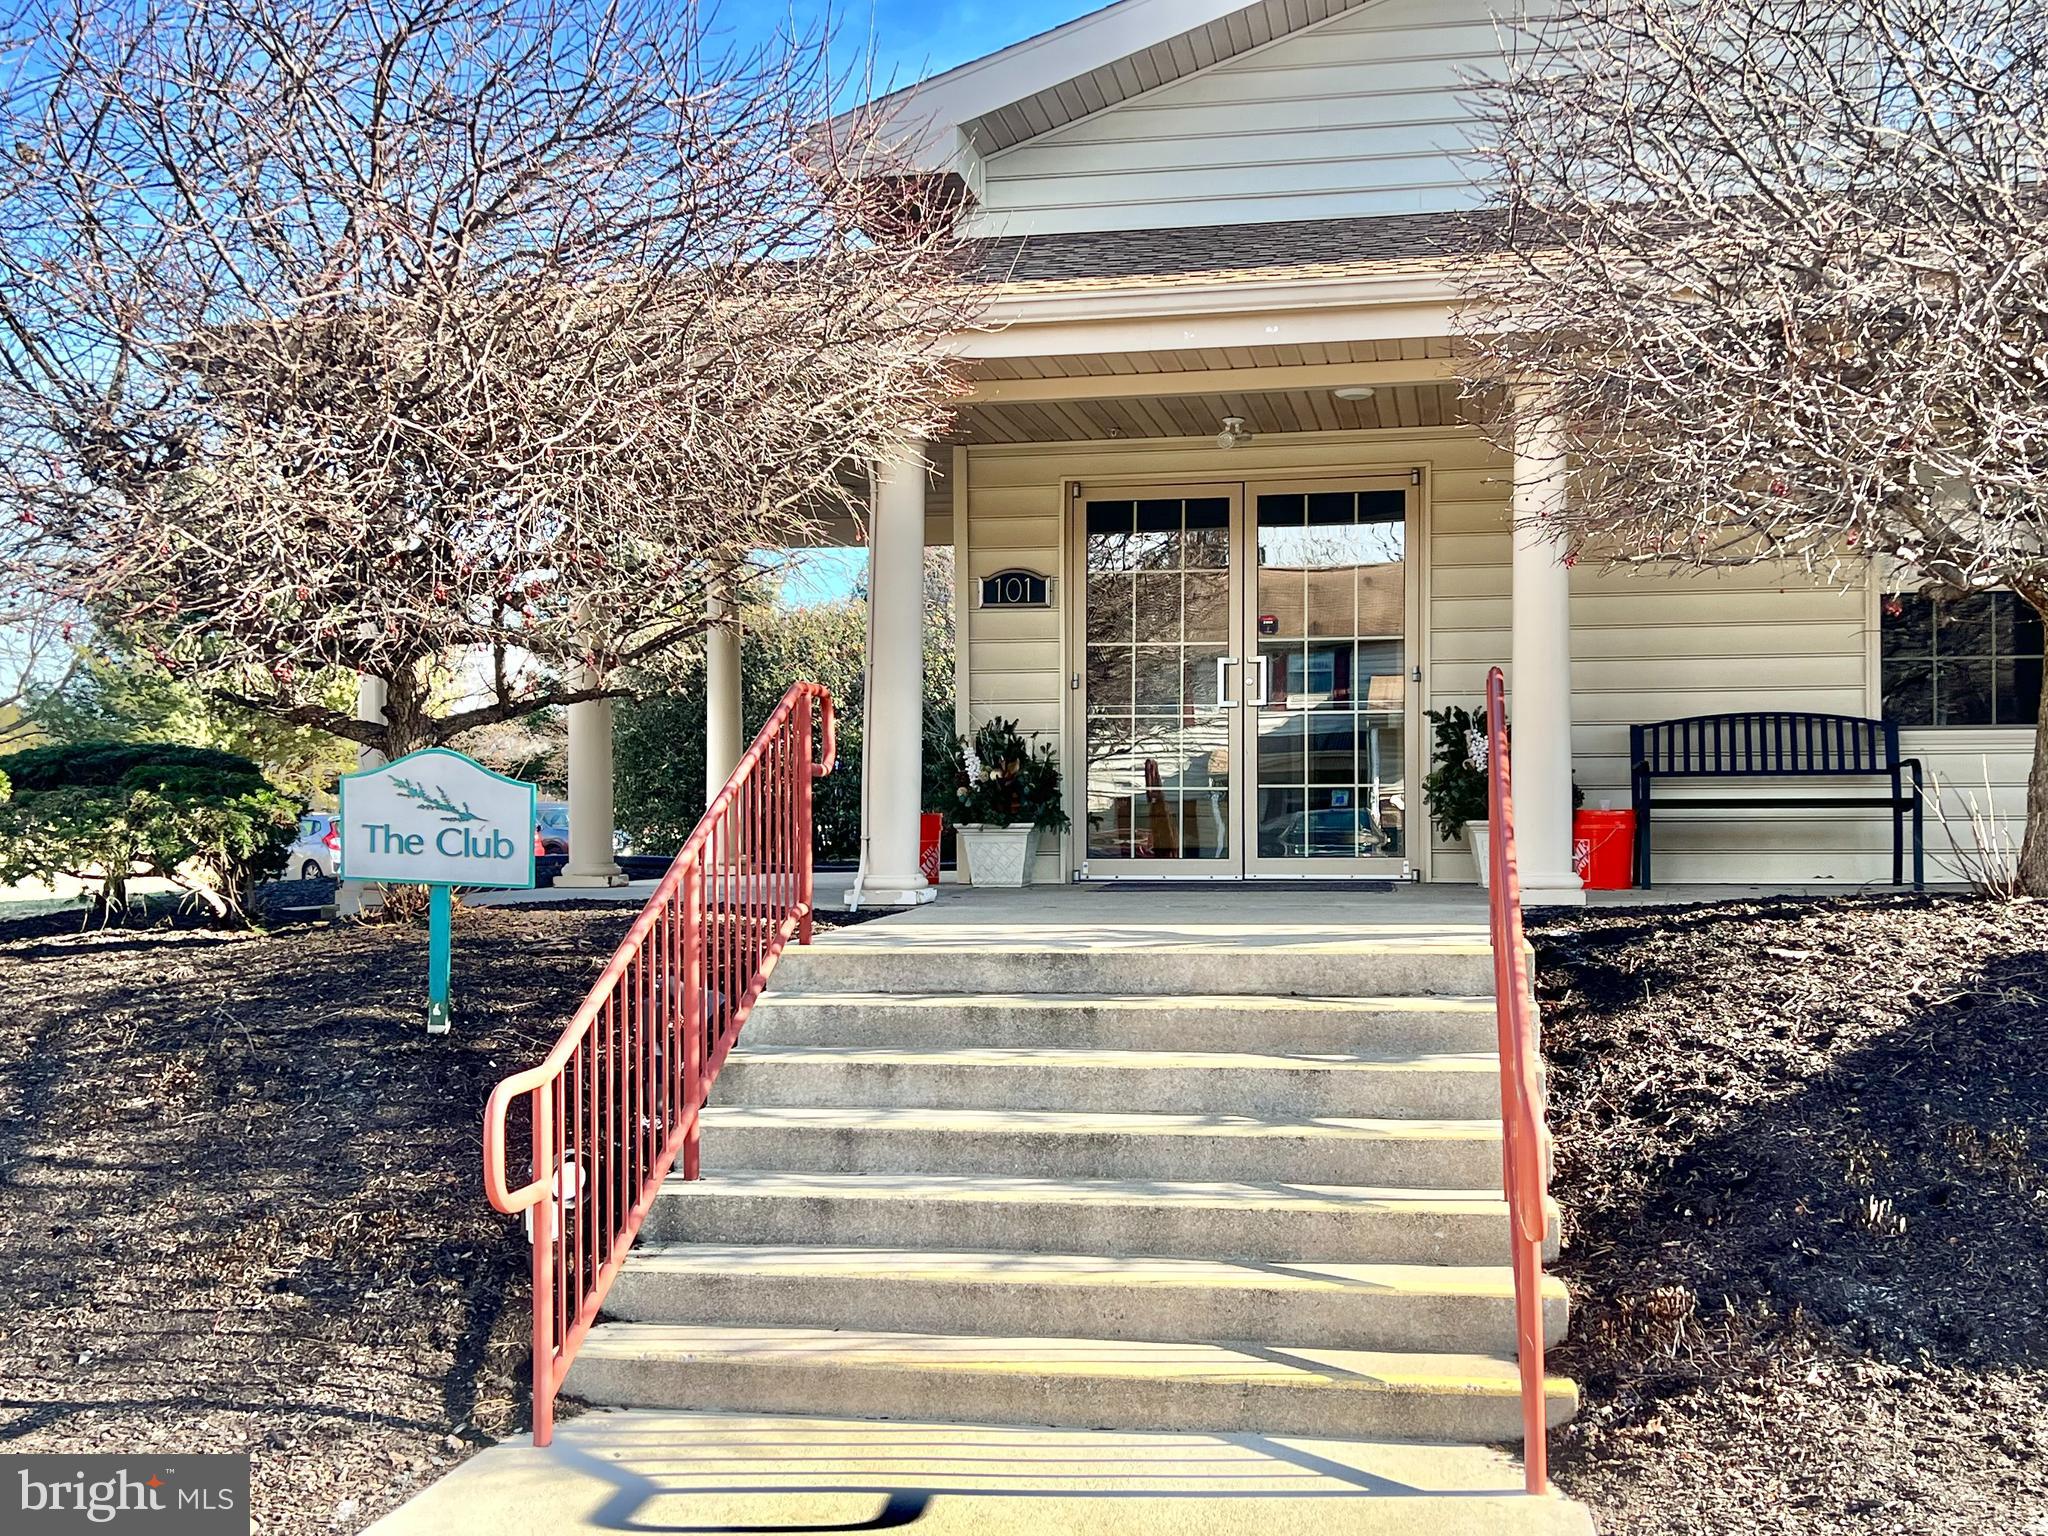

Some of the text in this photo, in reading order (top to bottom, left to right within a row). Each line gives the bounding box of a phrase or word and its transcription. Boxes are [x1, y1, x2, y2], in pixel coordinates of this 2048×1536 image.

[995, 577, 1030, 603] 101
[361, 823, 514, 859] The Club
